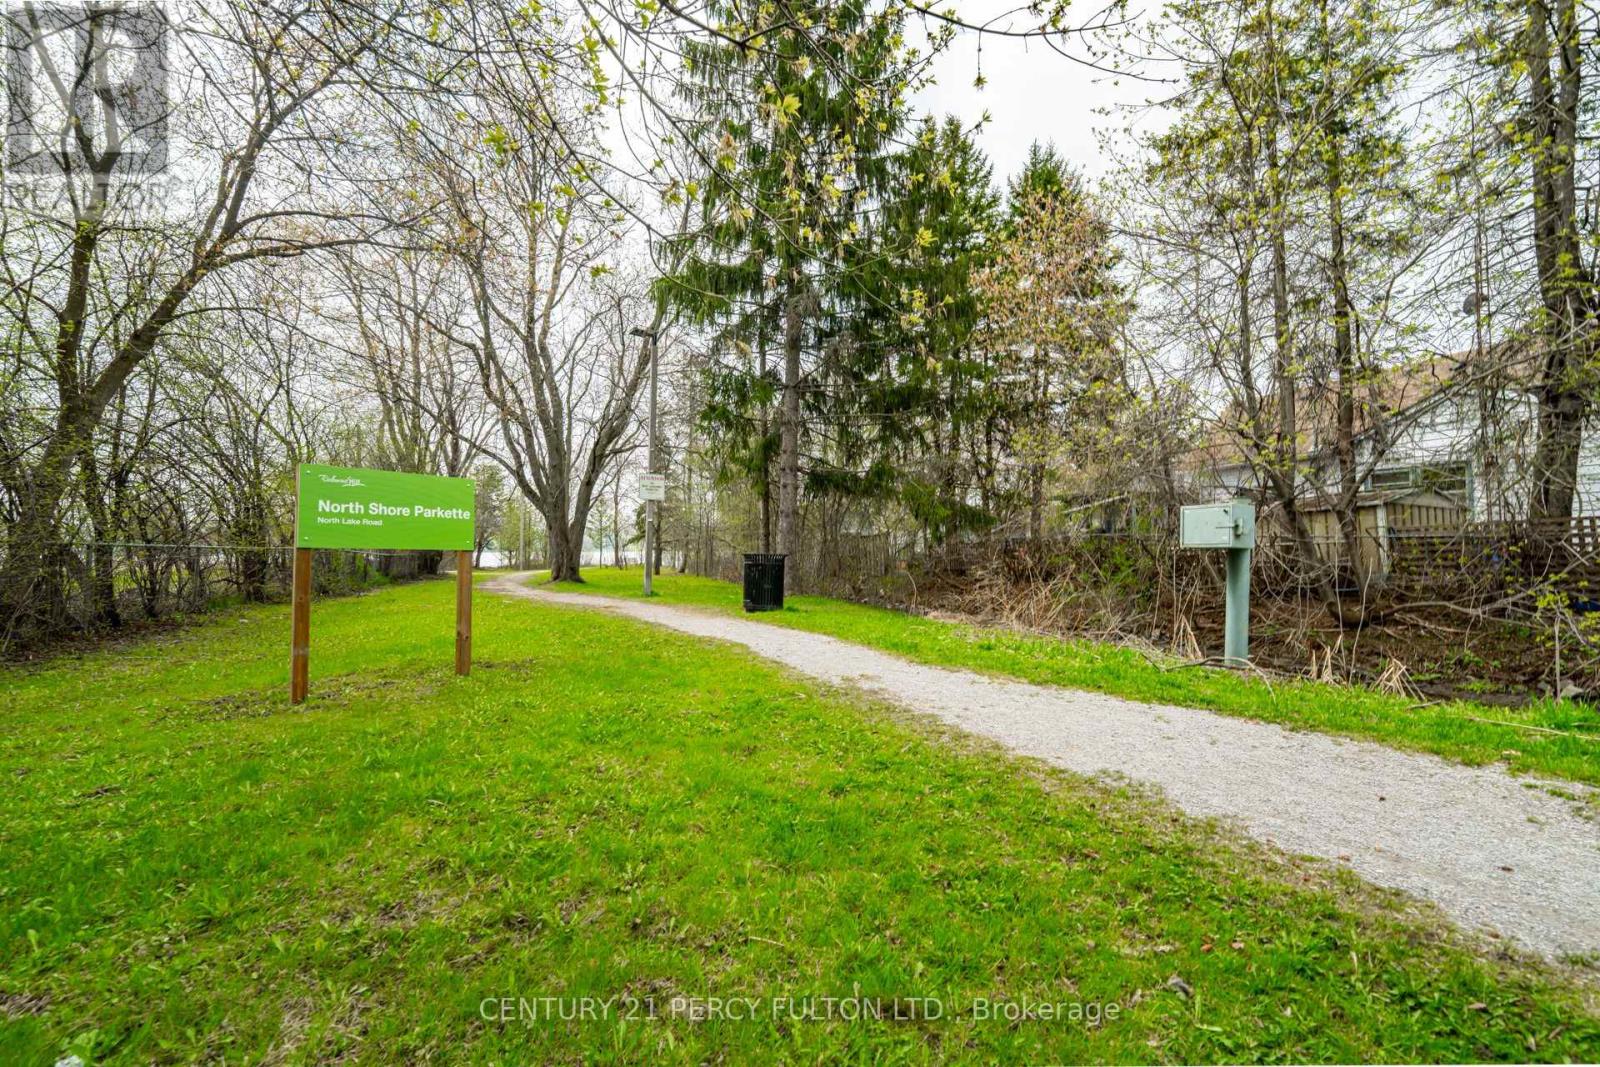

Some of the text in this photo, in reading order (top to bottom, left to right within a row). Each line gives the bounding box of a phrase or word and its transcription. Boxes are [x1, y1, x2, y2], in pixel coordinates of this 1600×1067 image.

[318, 500, 471, 520] North Shore Parkette
[317, 517, 340, 525] North
[341, 518, 361, 526] Lake
